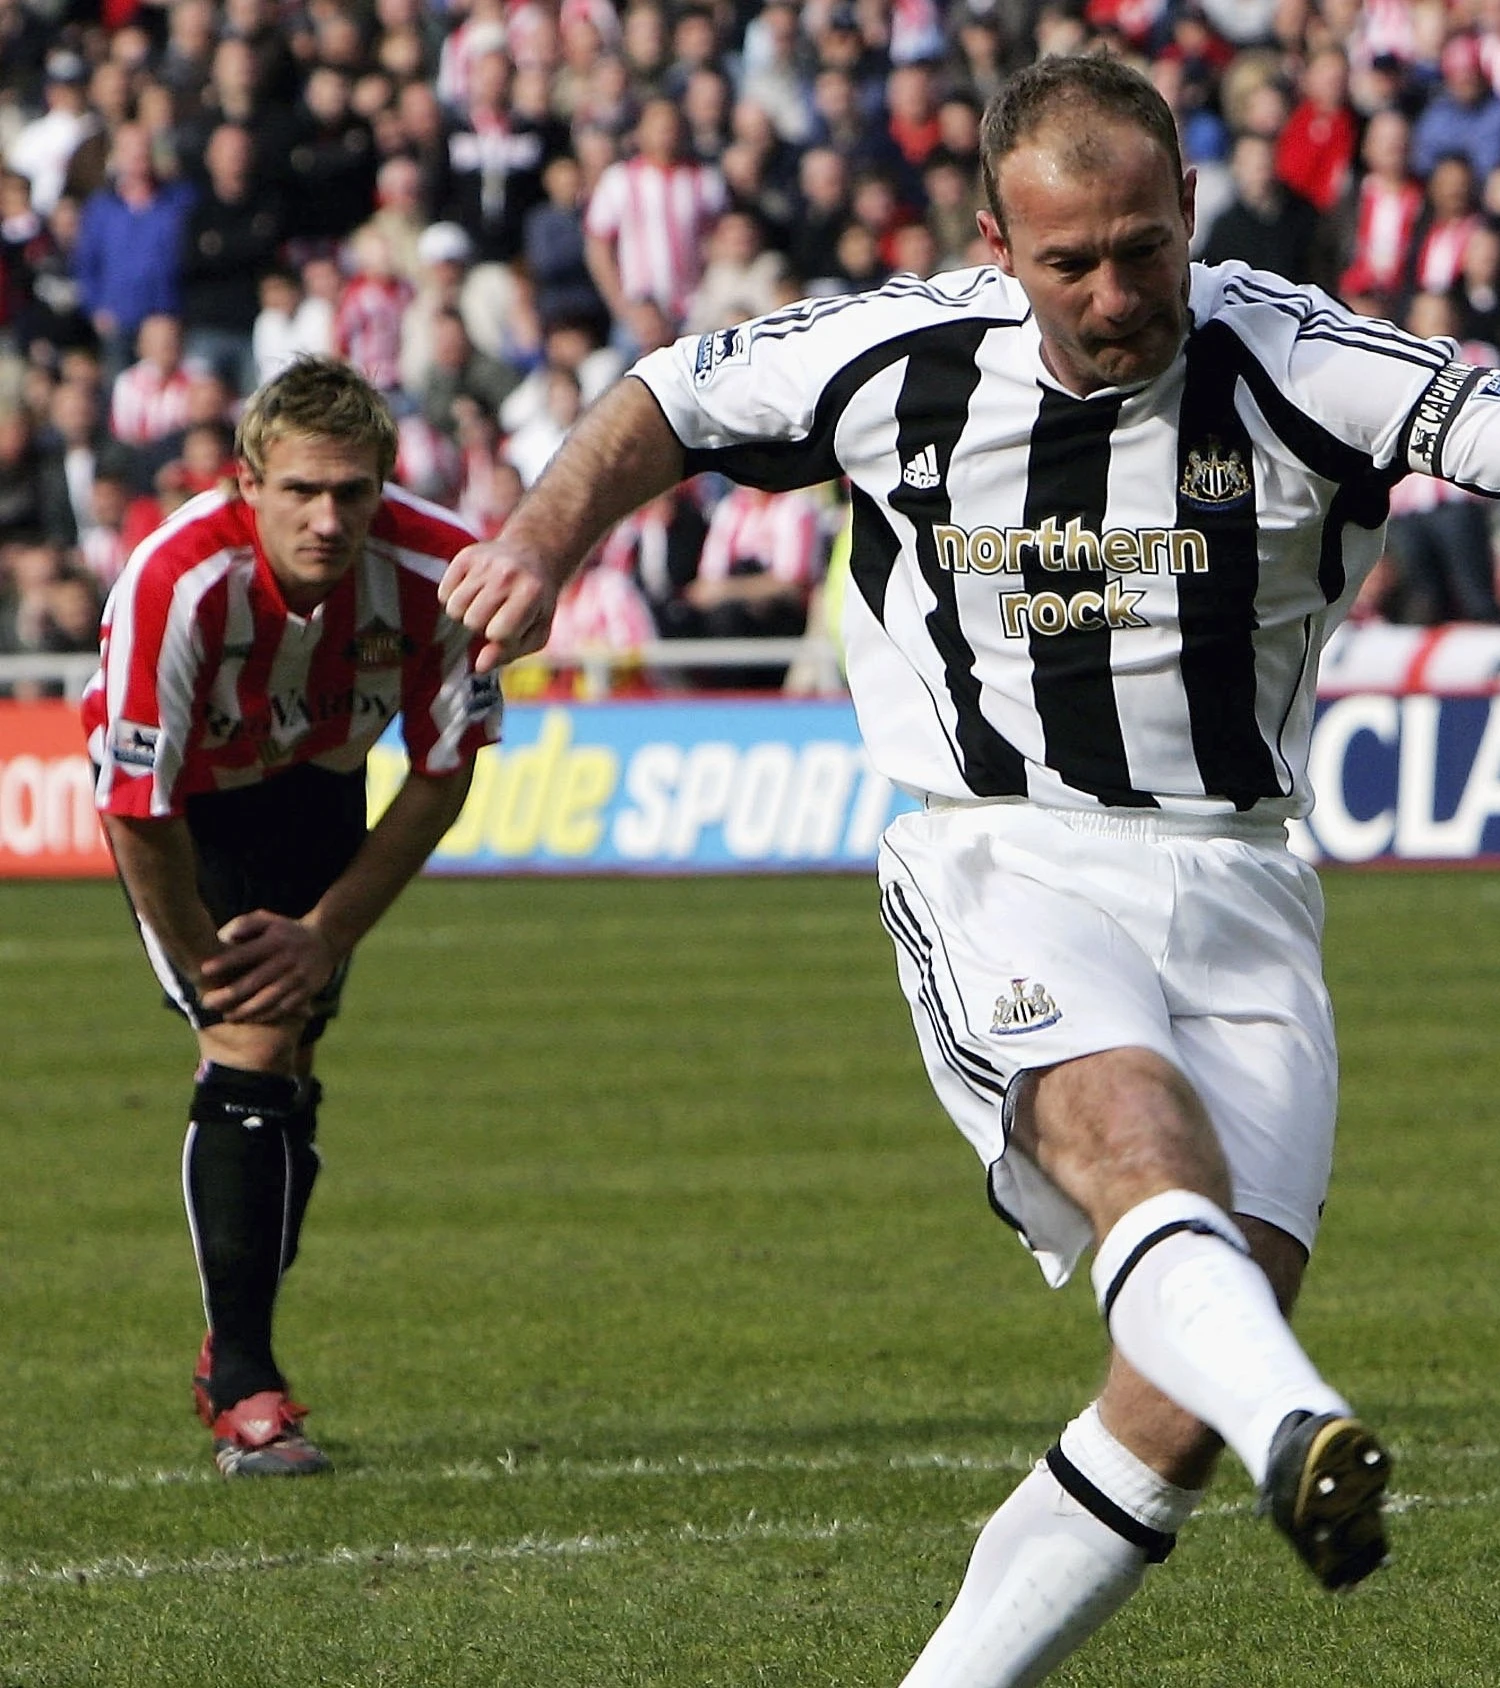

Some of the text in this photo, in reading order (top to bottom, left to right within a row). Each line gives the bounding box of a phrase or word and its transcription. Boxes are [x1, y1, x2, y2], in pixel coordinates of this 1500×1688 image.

[931, 513, 1209, 574] northern
[999, 579, 1148, 639] rock
[611, 740, 895, 860] SPORT
